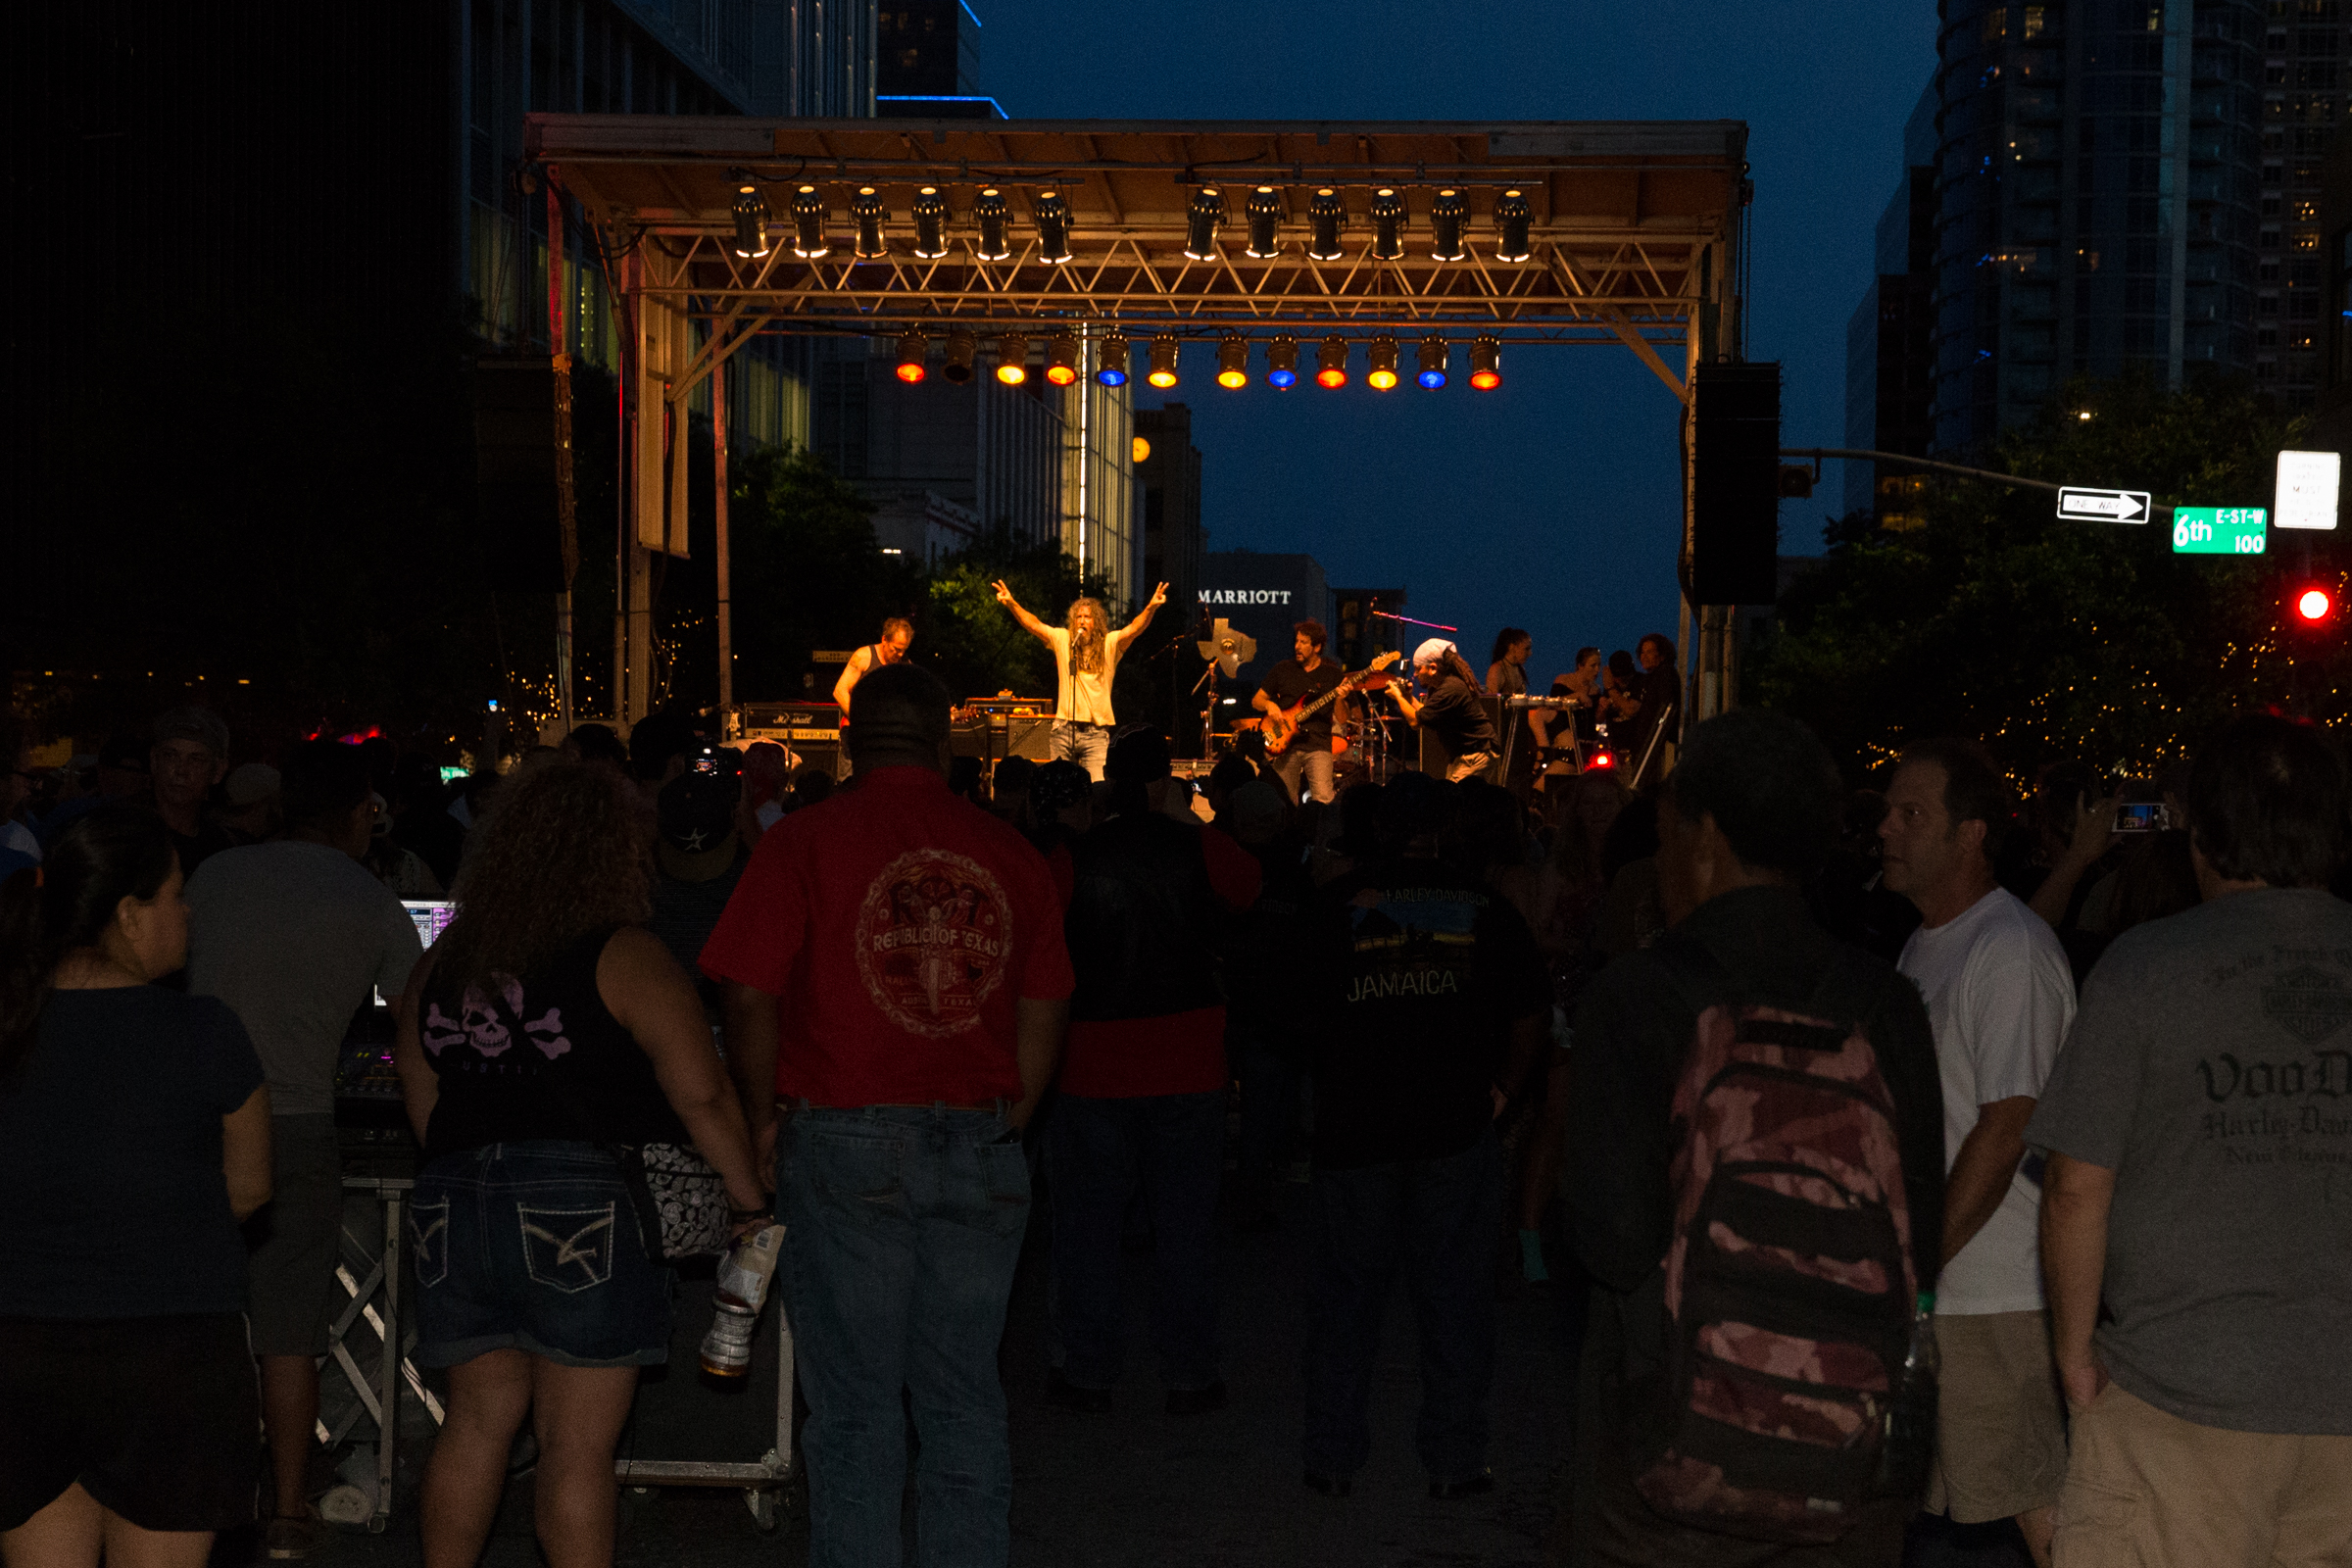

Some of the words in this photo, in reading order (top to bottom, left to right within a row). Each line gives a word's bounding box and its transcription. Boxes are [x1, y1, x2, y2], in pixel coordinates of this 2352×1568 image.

[2068, 499, 2090, 510] ONE
[2097, 501, 2121, 511] WAY
[2216, 509, 2265, 524] E-ST-W
[2174, 514, 2212, 547] 6th
[2235, 535, 2264, 554] 100
[1198, 589, 1292, 605] MARRIOTT
[772, 714, 813, 724] Mashall
[873, 926, 933, 952] REPBLIC
[940, 928, 958, 946] OF
[1347, 969, 1458, 1003] JAMAICA
[944, 997, 972, 1005] TEXA
